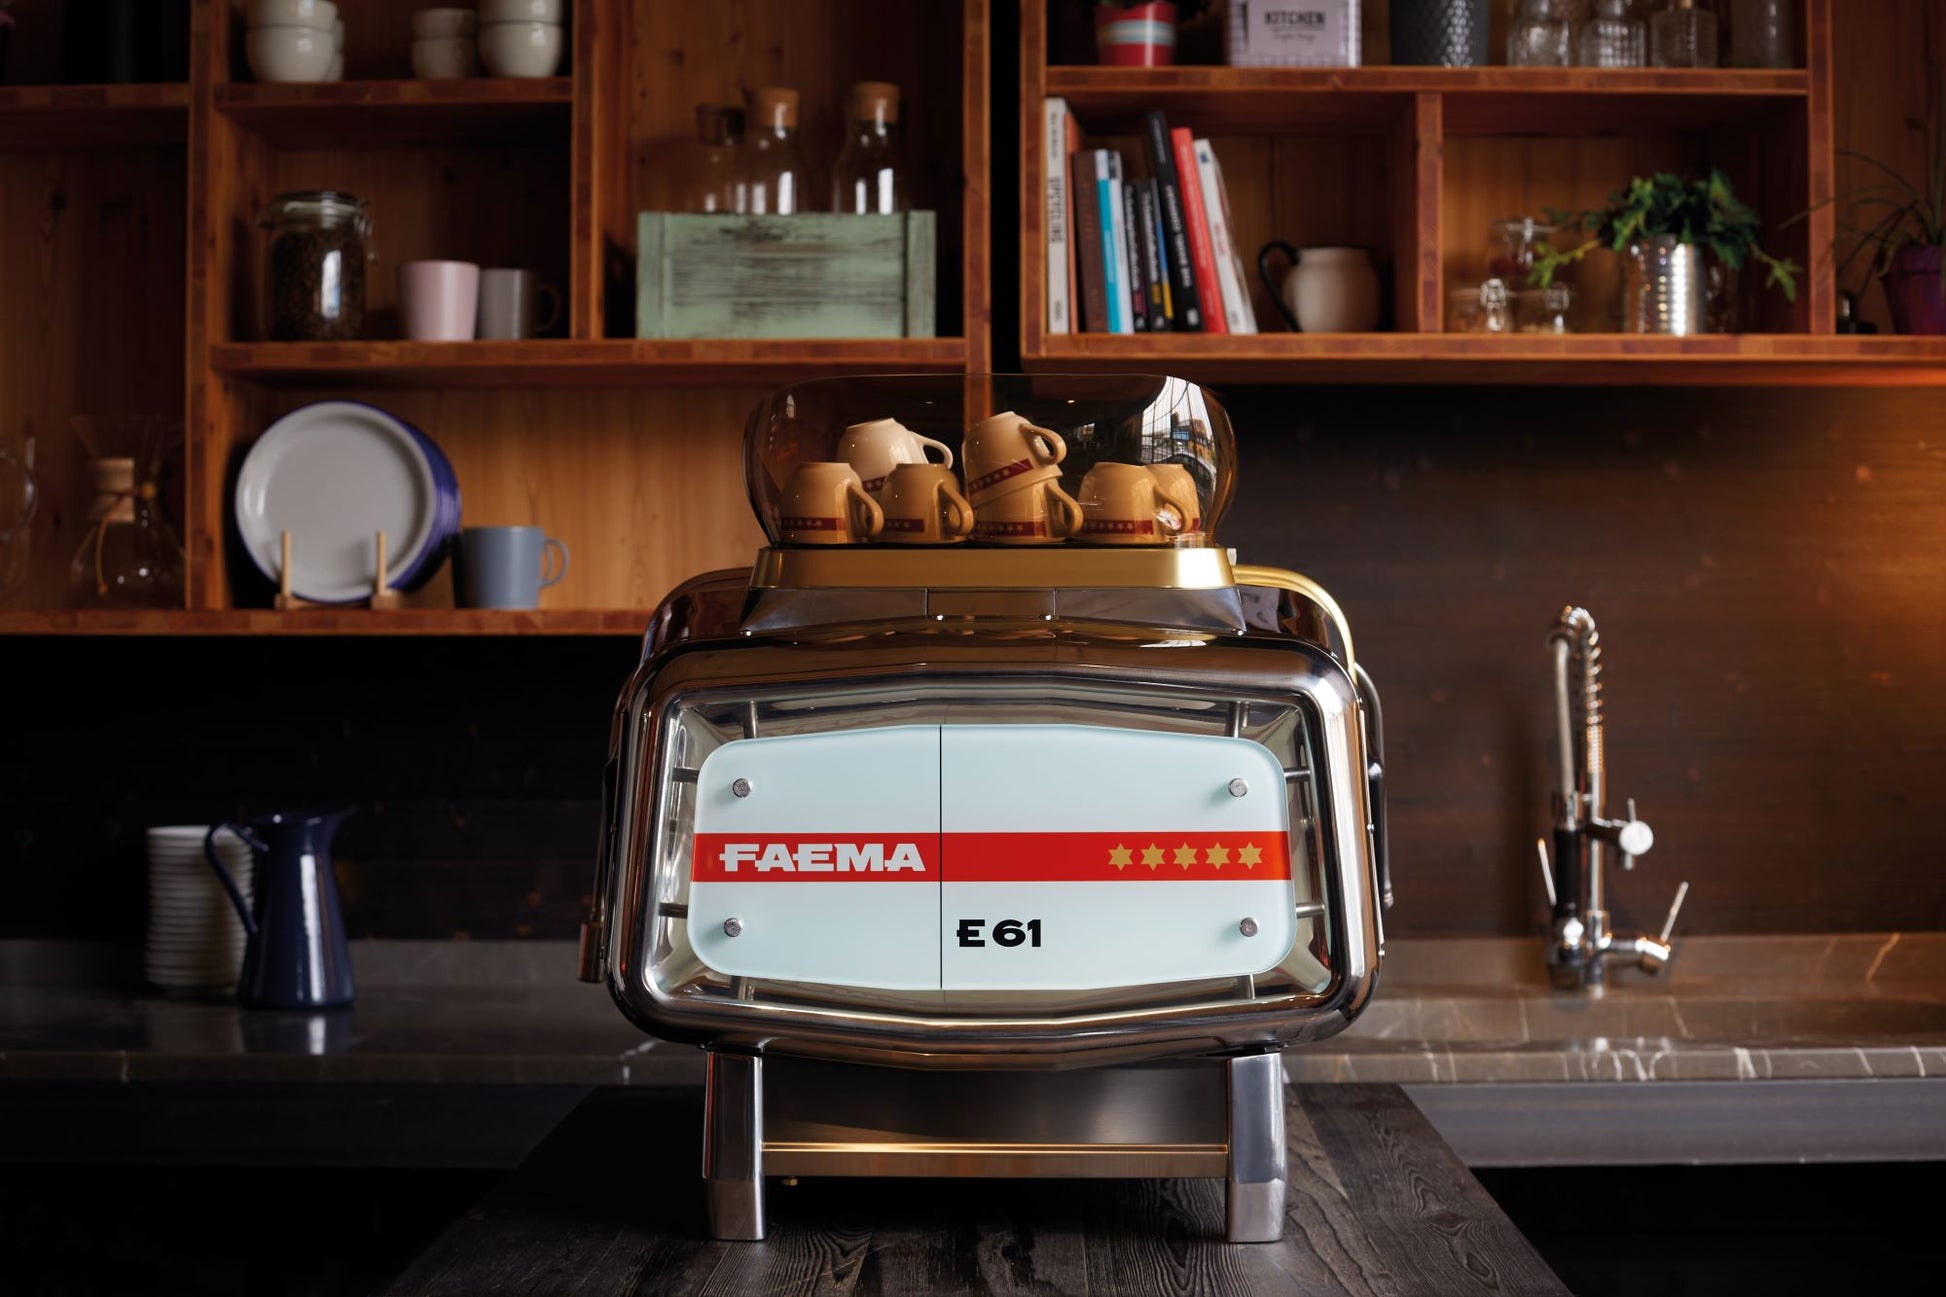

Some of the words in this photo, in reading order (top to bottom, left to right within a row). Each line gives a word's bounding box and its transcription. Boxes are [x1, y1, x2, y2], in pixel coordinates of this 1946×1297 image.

[1265, 10, 1326, 25] KITCHEN
[719, 843, 926, 872] FAEMA
[956, 919, 986, 948] E
[992, 919, 1042, 948] 61
